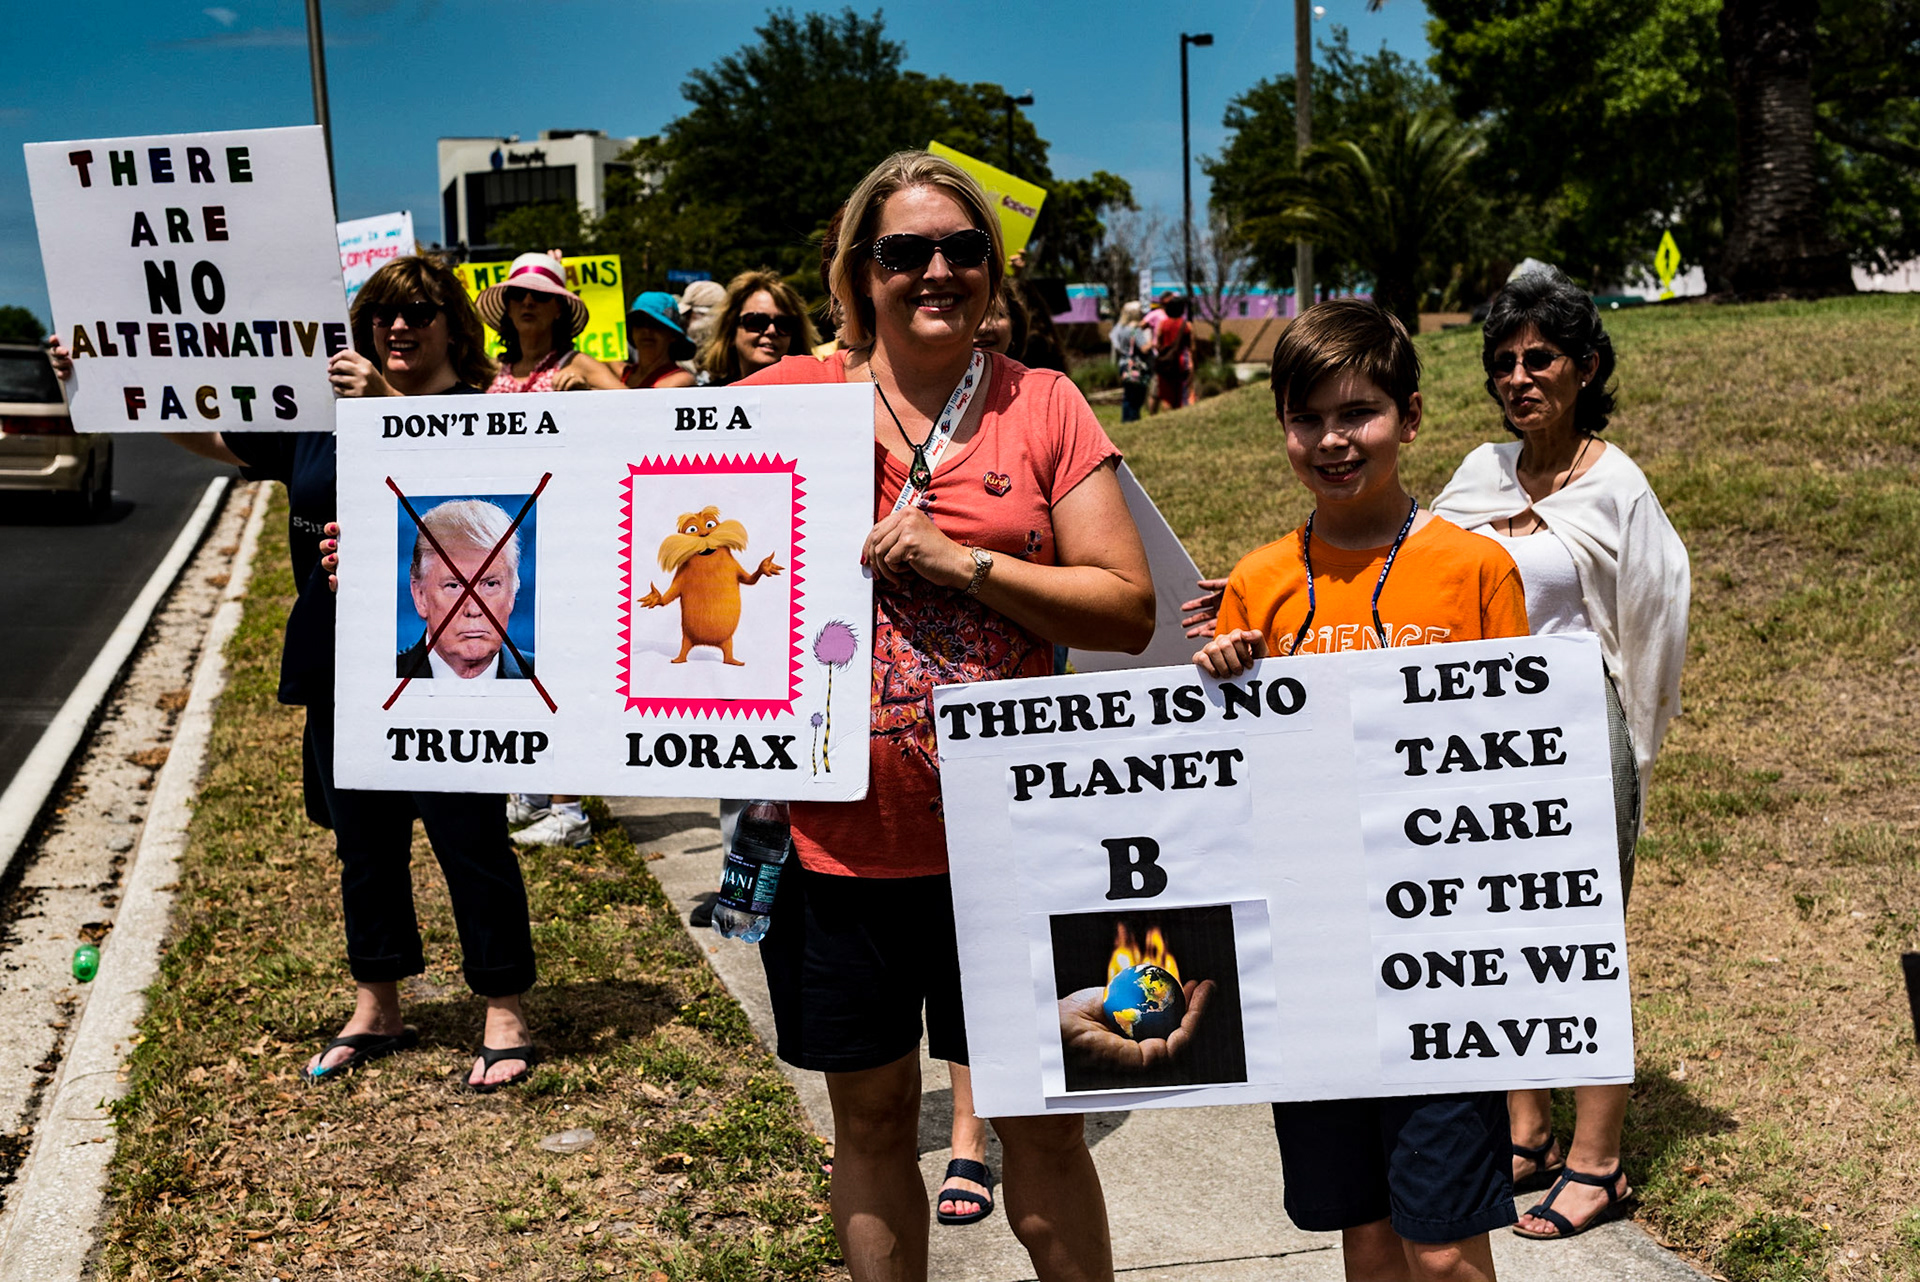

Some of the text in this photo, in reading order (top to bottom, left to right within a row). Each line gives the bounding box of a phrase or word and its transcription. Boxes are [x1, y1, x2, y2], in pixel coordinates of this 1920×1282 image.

[69, 147, 253, 187] THERE
[131, 206, 229, 247] ARE
[144, 260, 226, 314] NO
[71, 320, 349, 359] ALTERNATIVE
[123, 385, 298, 422] FACTS
[382, 411, 559, 438] DON'T BE A
[675, 406, 751, 430] BE A
[1400, 653, 1549, 703] LET'S
[939, 677, 1307, 740] THERE IS NO
[387, 728, 548, 765] TRUMP
[626, 732, 797, 770] LORAX
[1395, 727, 1567, 776] TAKE
[1010, 749, 1244, 801] PLANET
[1404, 798, 1572, 845] CARE
[1101, 837, 1168, 900] B
[1386, 869, 1602, 918] OF THE
[1382, 943, 1619, 990] ONE WE
[1409, 1016, 1599, 1060] HAVE!
